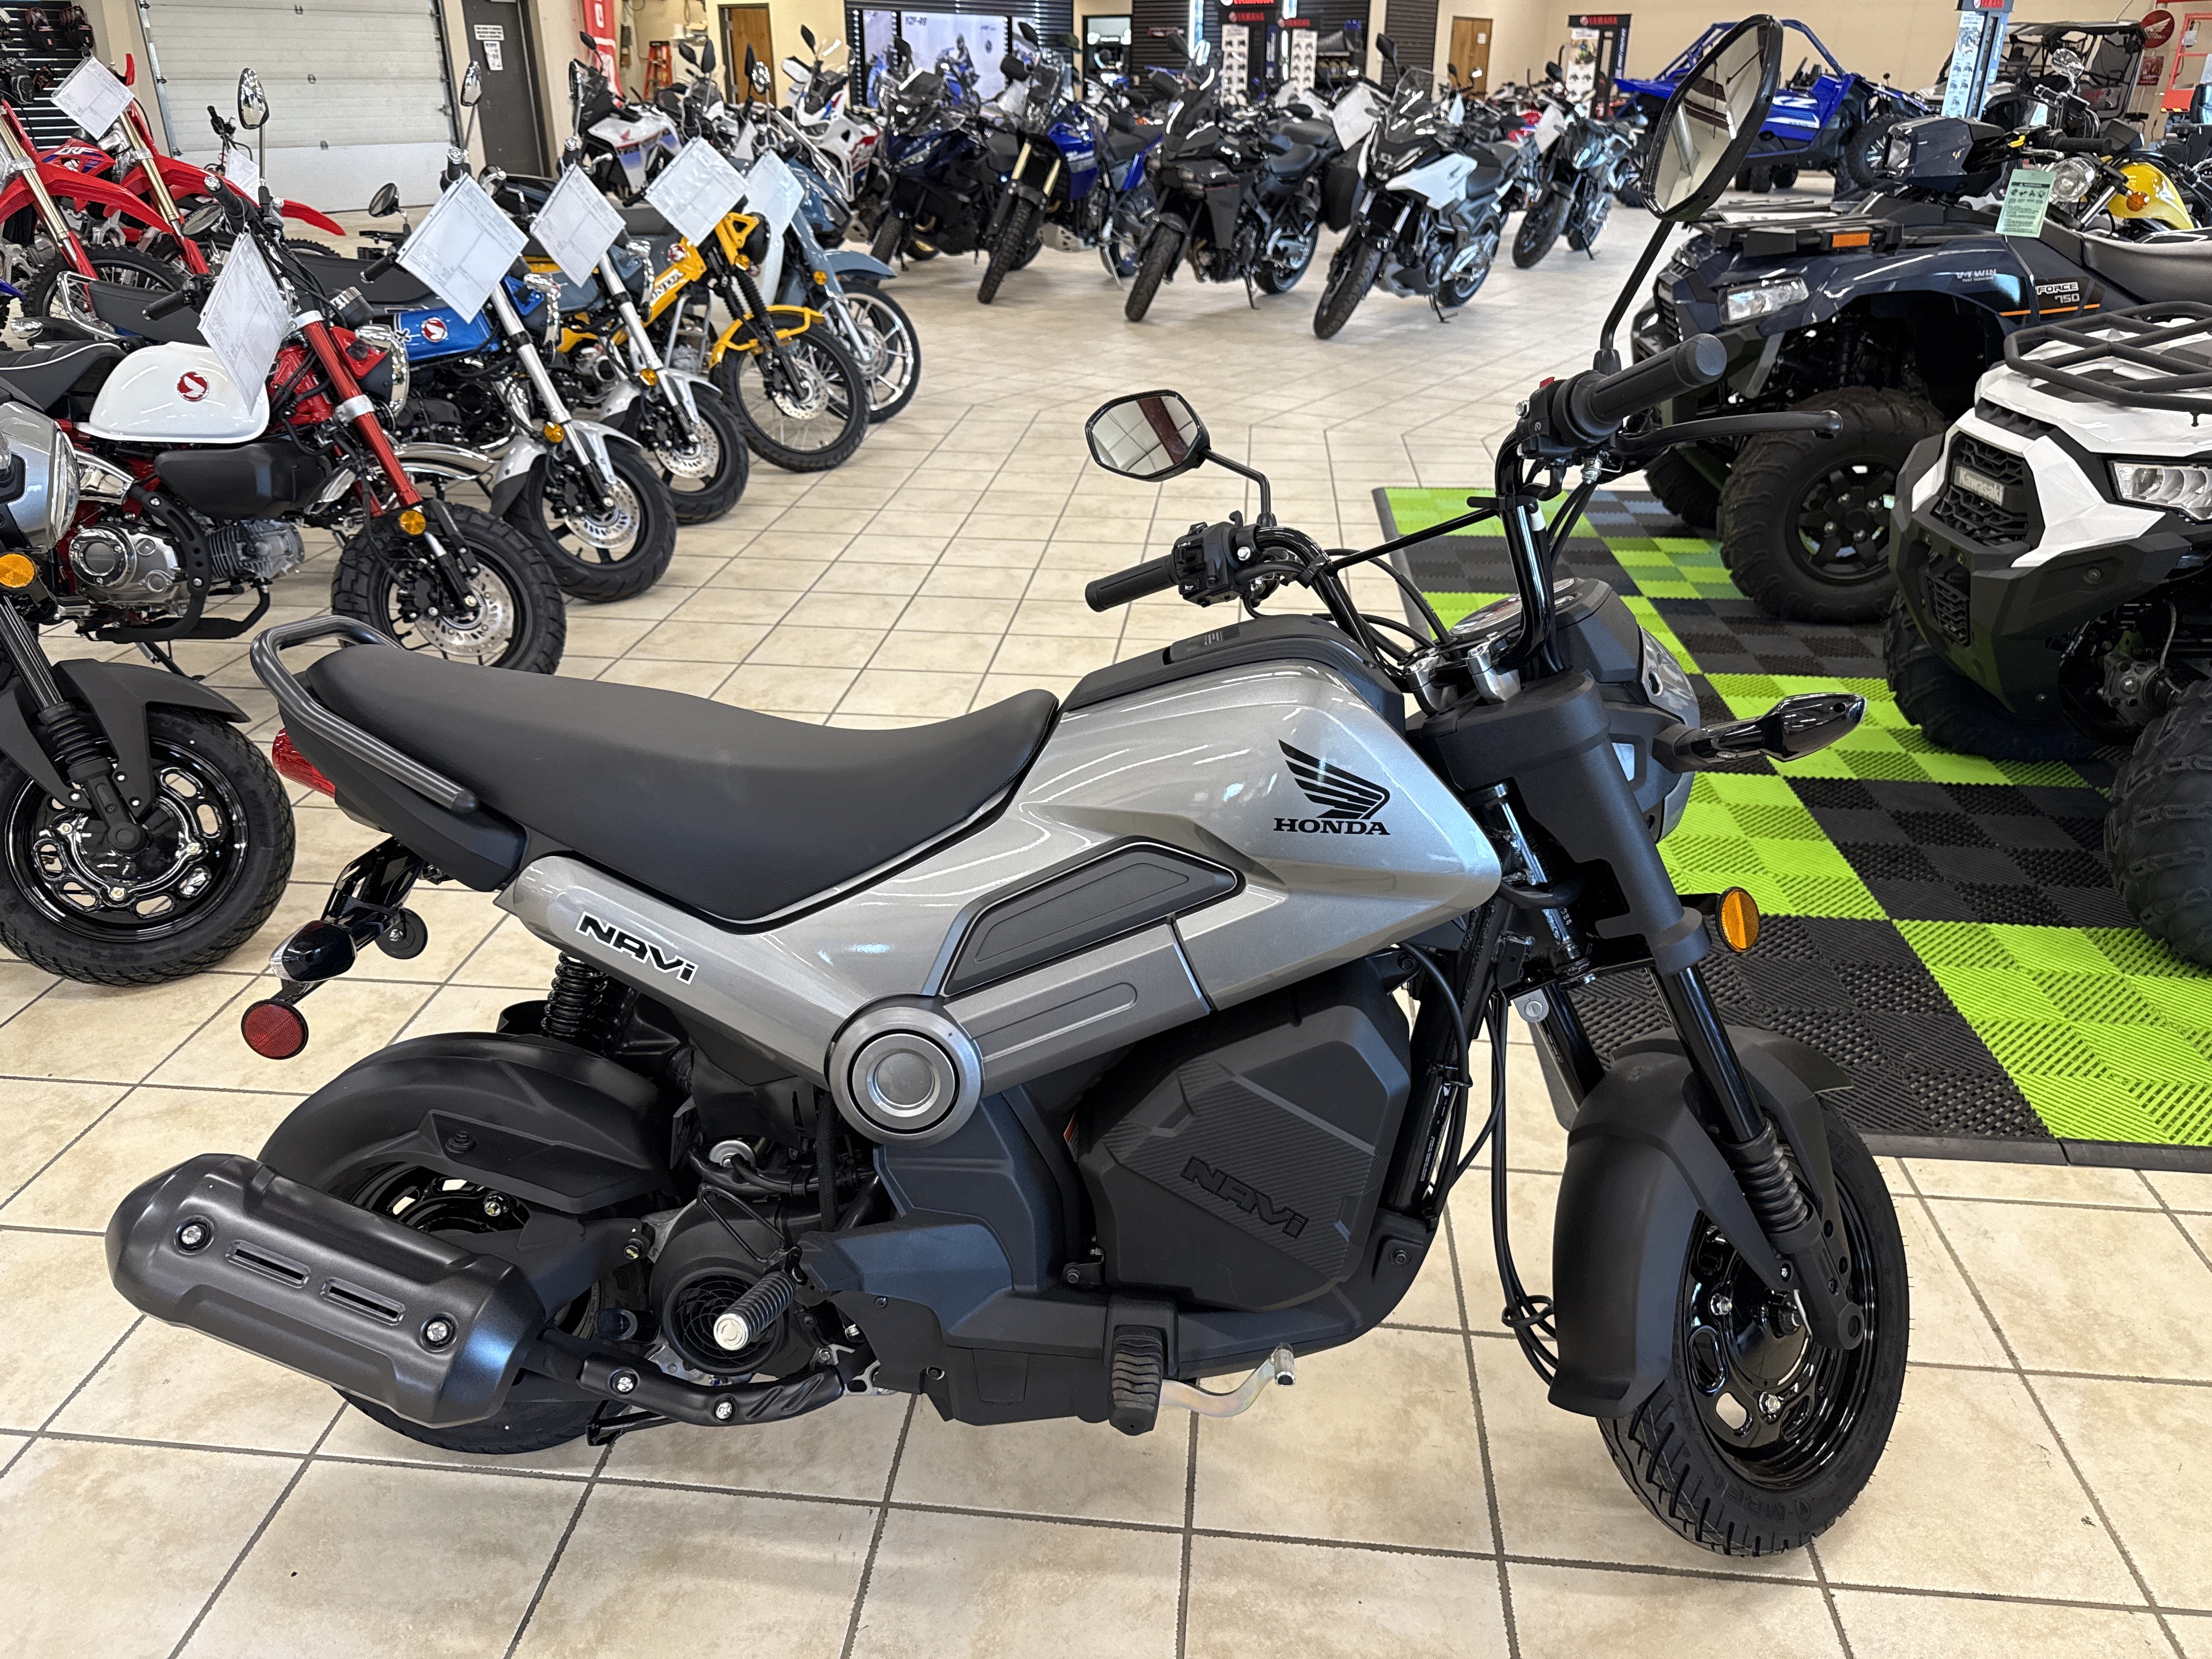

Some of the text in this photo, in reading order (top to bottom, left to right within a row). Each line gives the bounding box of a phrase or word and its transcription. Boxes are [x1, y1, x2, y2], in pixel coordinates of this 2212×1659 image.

[53, 146, 99, 155] CRF
[2055, 293, 2080, 304] 750
[1959, 469, 2003, 505] Kawasaki
[1273, 818, 1391, 835] HONDA
